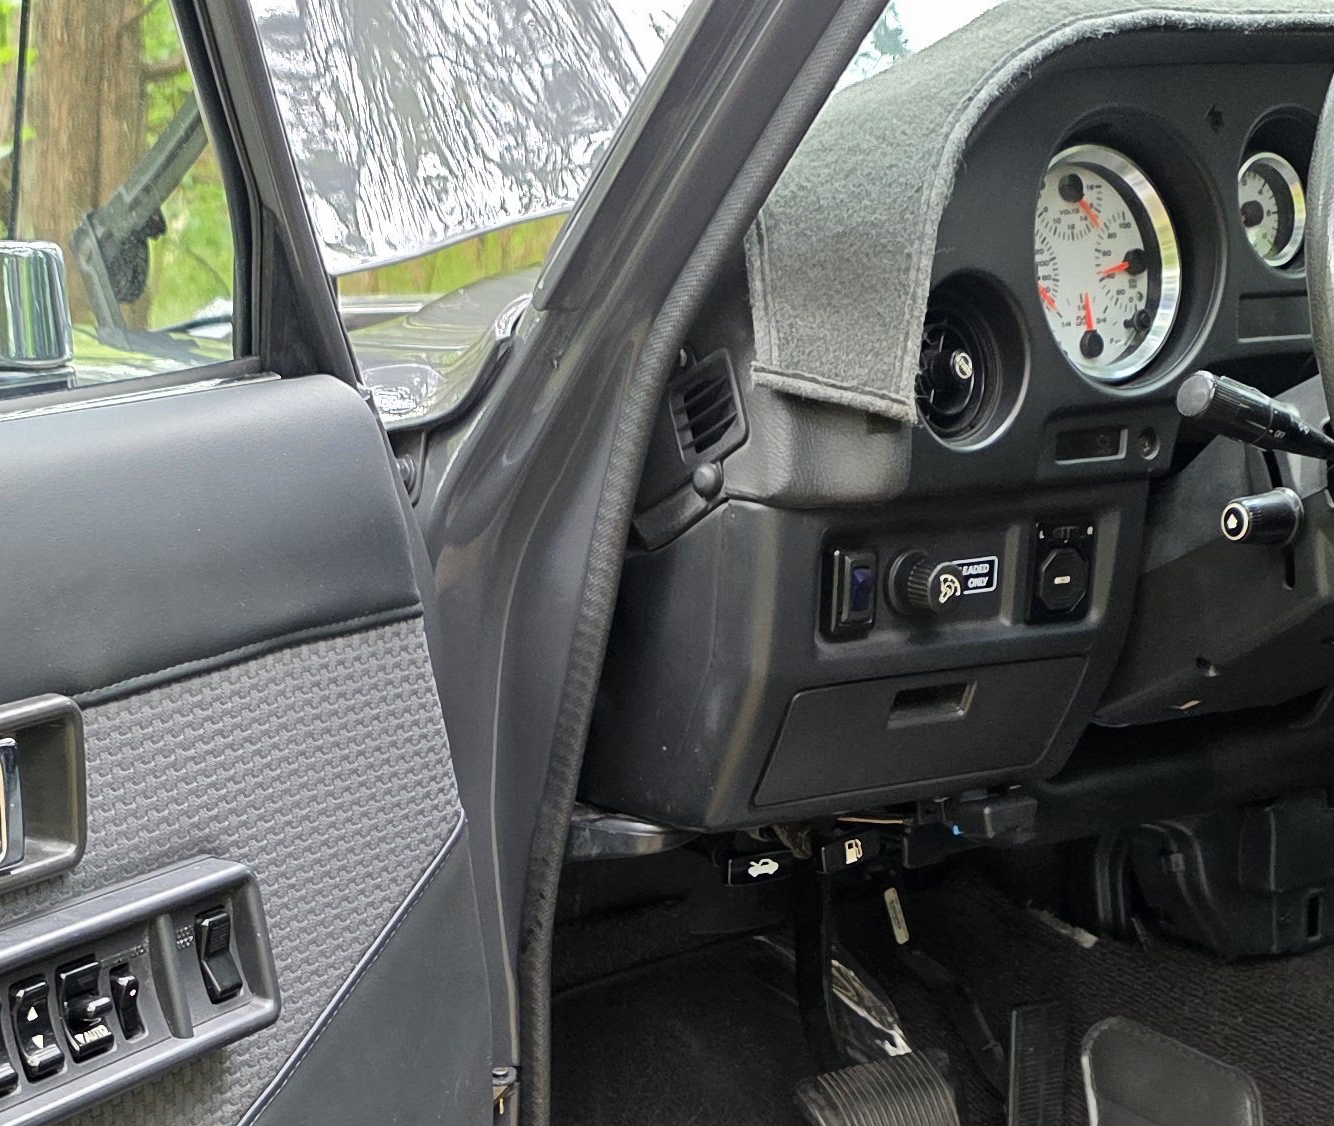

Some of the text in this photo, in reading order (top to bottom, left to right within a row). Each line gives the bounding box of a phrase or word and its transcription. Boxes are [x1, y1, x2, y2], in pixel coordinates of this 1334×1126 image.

[1059, 208, 1080, 216] VOLTS
[959, 563, 990, 575] EADED
[968, 576, 989, 588] ONLY
[84, 1025, 112, 1043] AUTO
